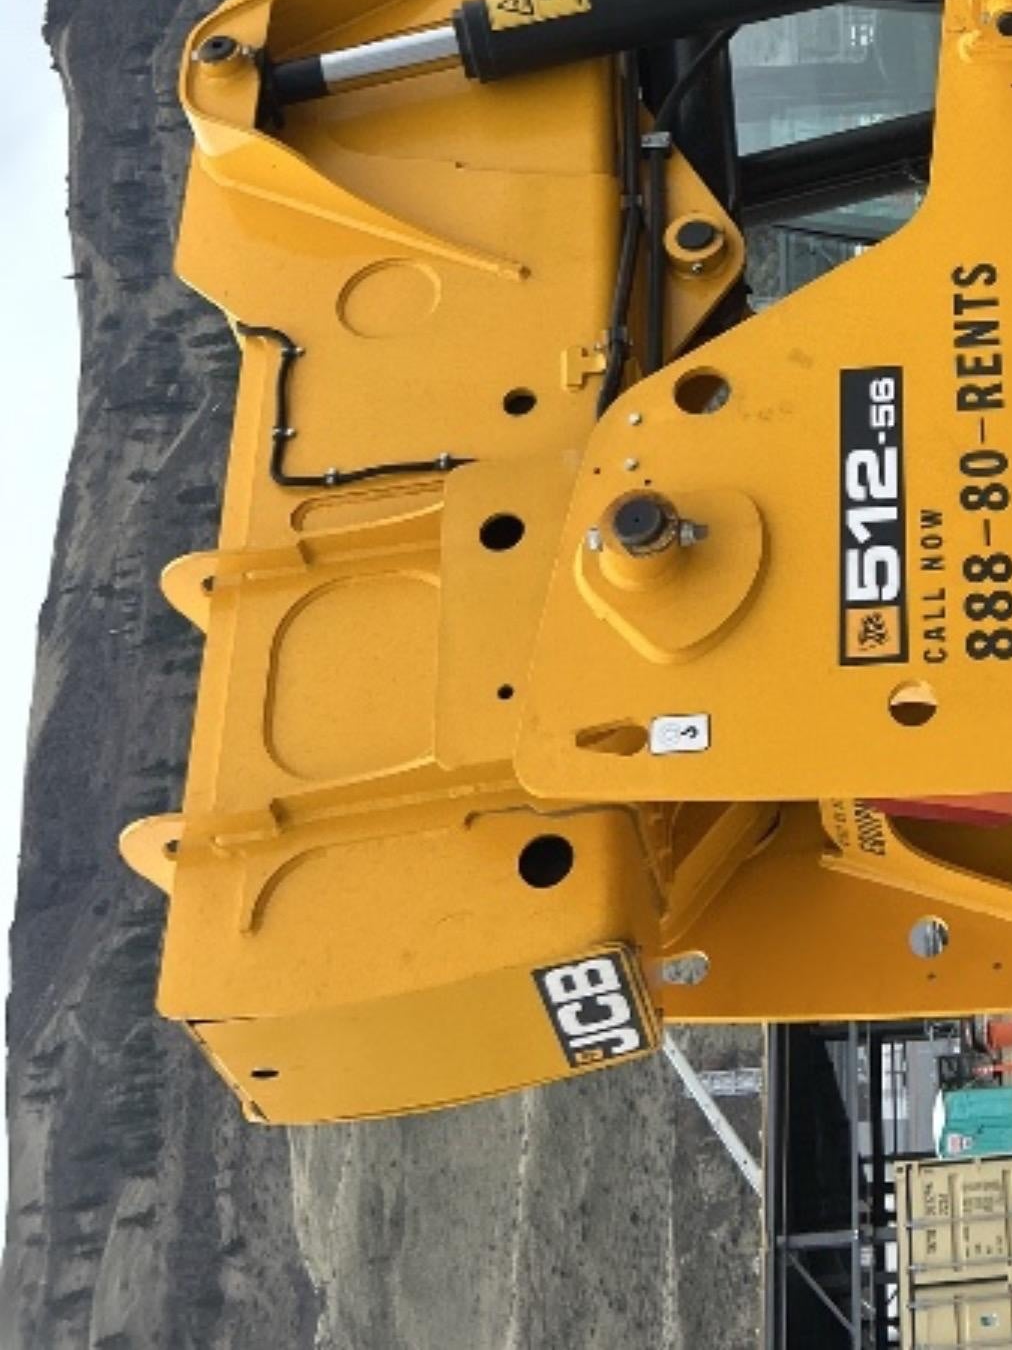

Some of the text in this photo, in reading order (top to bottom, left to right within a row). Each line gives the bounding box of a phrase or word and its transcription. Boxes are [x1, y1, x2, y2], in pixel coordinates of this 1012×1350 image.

[920, 509, 947, 664] CALL NOW
[543, 959, 639, 1053] JCB
